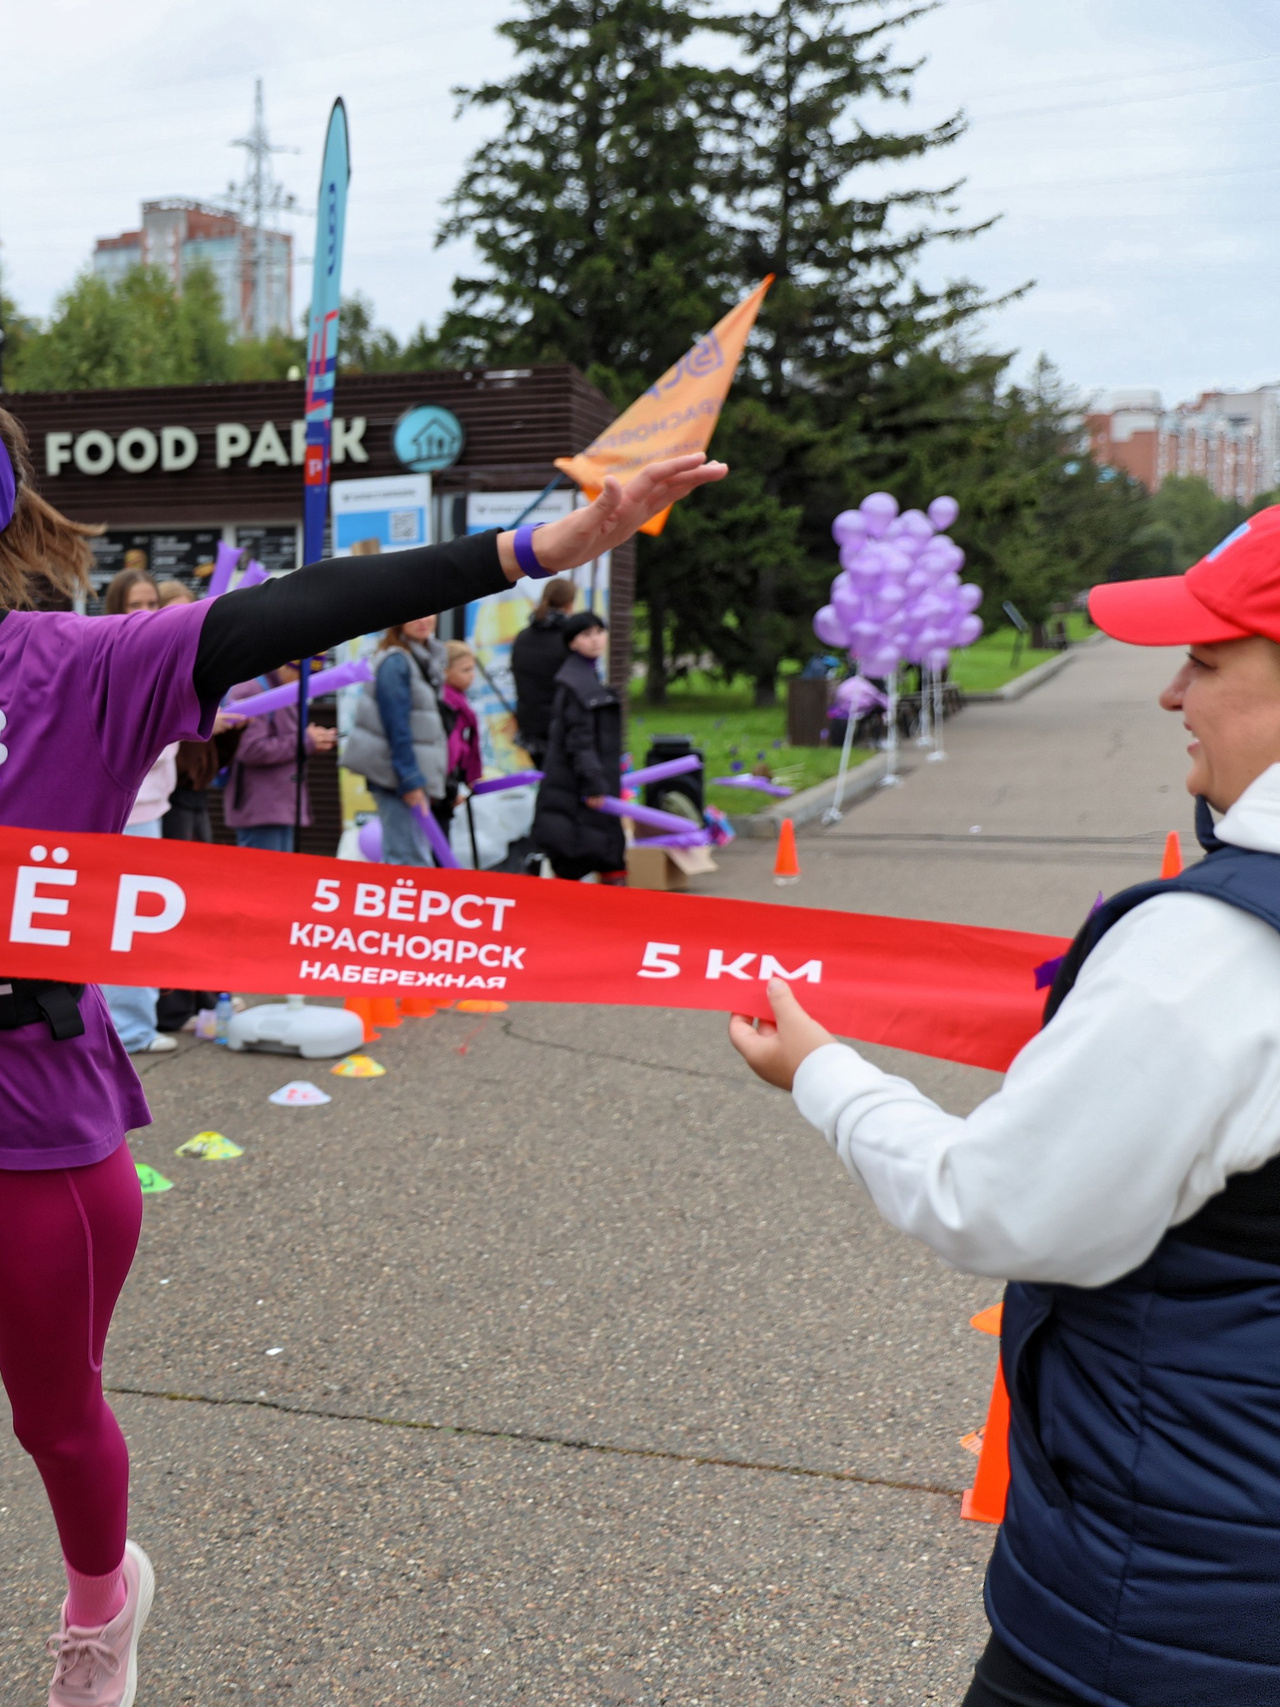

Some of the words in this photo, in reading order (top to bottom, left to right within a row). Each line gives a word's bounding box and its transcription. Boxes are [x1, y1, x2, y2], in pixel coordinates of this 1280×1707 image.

[45, 426, 198, 476] FOOD
[311, 878, 342, 913] 5
[353, 878, 517, 932] ВЁРСТ
[289, 921, 527, 970] КРАСНОЯРСК
[636, 941, 682, 979] 5
[705, 948, 823, 983] КМ
[299, 959, 508, 989] НАБЕРЕЖНАЯ
